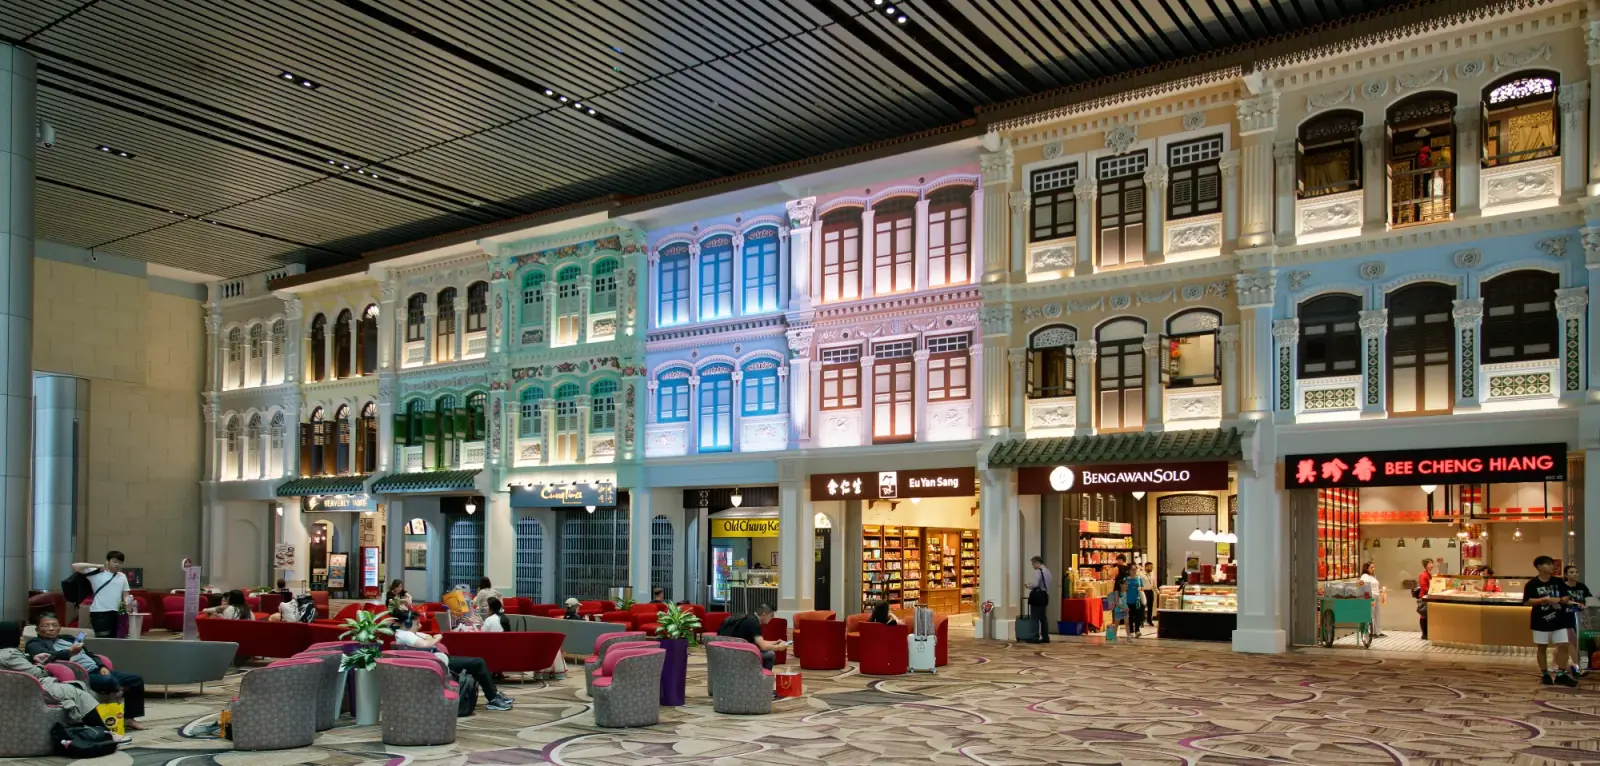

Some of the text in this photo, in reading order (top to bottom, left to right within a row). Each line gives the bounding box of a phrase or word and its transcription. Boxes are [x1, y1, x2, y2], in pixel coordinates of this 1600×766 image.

[1385, 455, 1554, 475] BEE CHENG HIANG
[827, 477, 862, 496] 余仁生
[909, 477, 959, 489] Eu Yan Sang
[724, 519, 739, 532] Old
[739, 519, 767, 534] Chang
